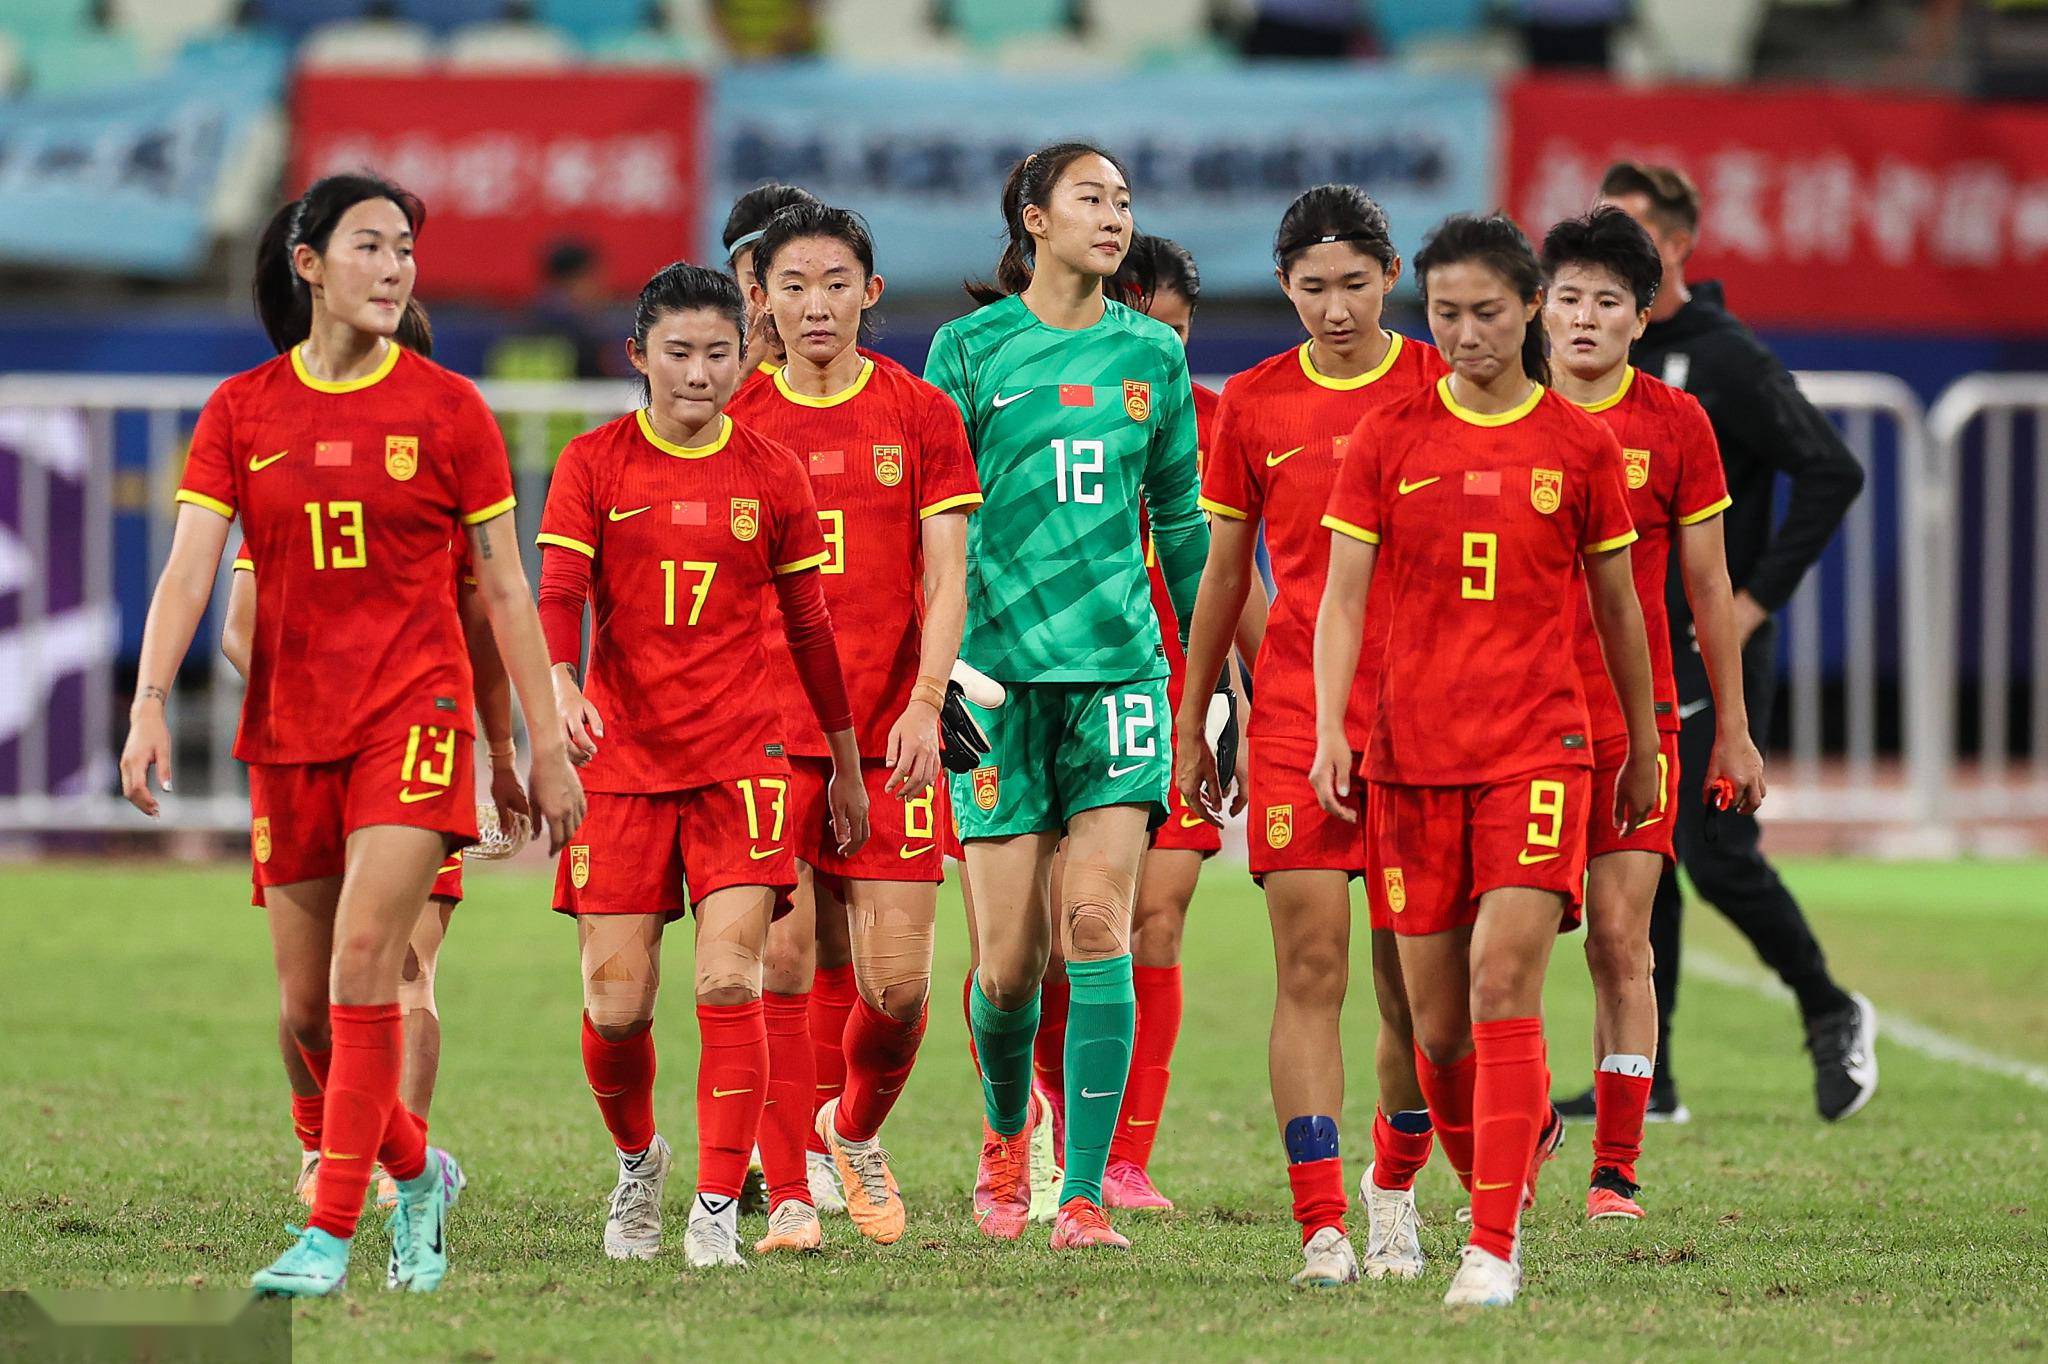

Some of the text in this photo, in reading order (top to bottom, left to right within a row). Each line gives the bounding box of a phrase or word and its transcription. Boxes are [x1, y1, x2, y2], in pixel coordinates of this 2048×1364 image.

[1126, 383, 1147, 393] CFA
[876, 448, 899, 456] CFA
[1051, 439, 1104, 504] 12
[305, 501, 367, 570] 13
[733, 501, 756, 511] CFA
[660, 560, 718, 626] 17
[1461, 532, 1497, 601] 9
[1102, 693, 1156, 757] 12
[401, 725, 455, 790] 13
[975, 769, 996, 780] CFA
[736, 778, 787, 841] 17
[1527, 780, 1565, 848] 9
